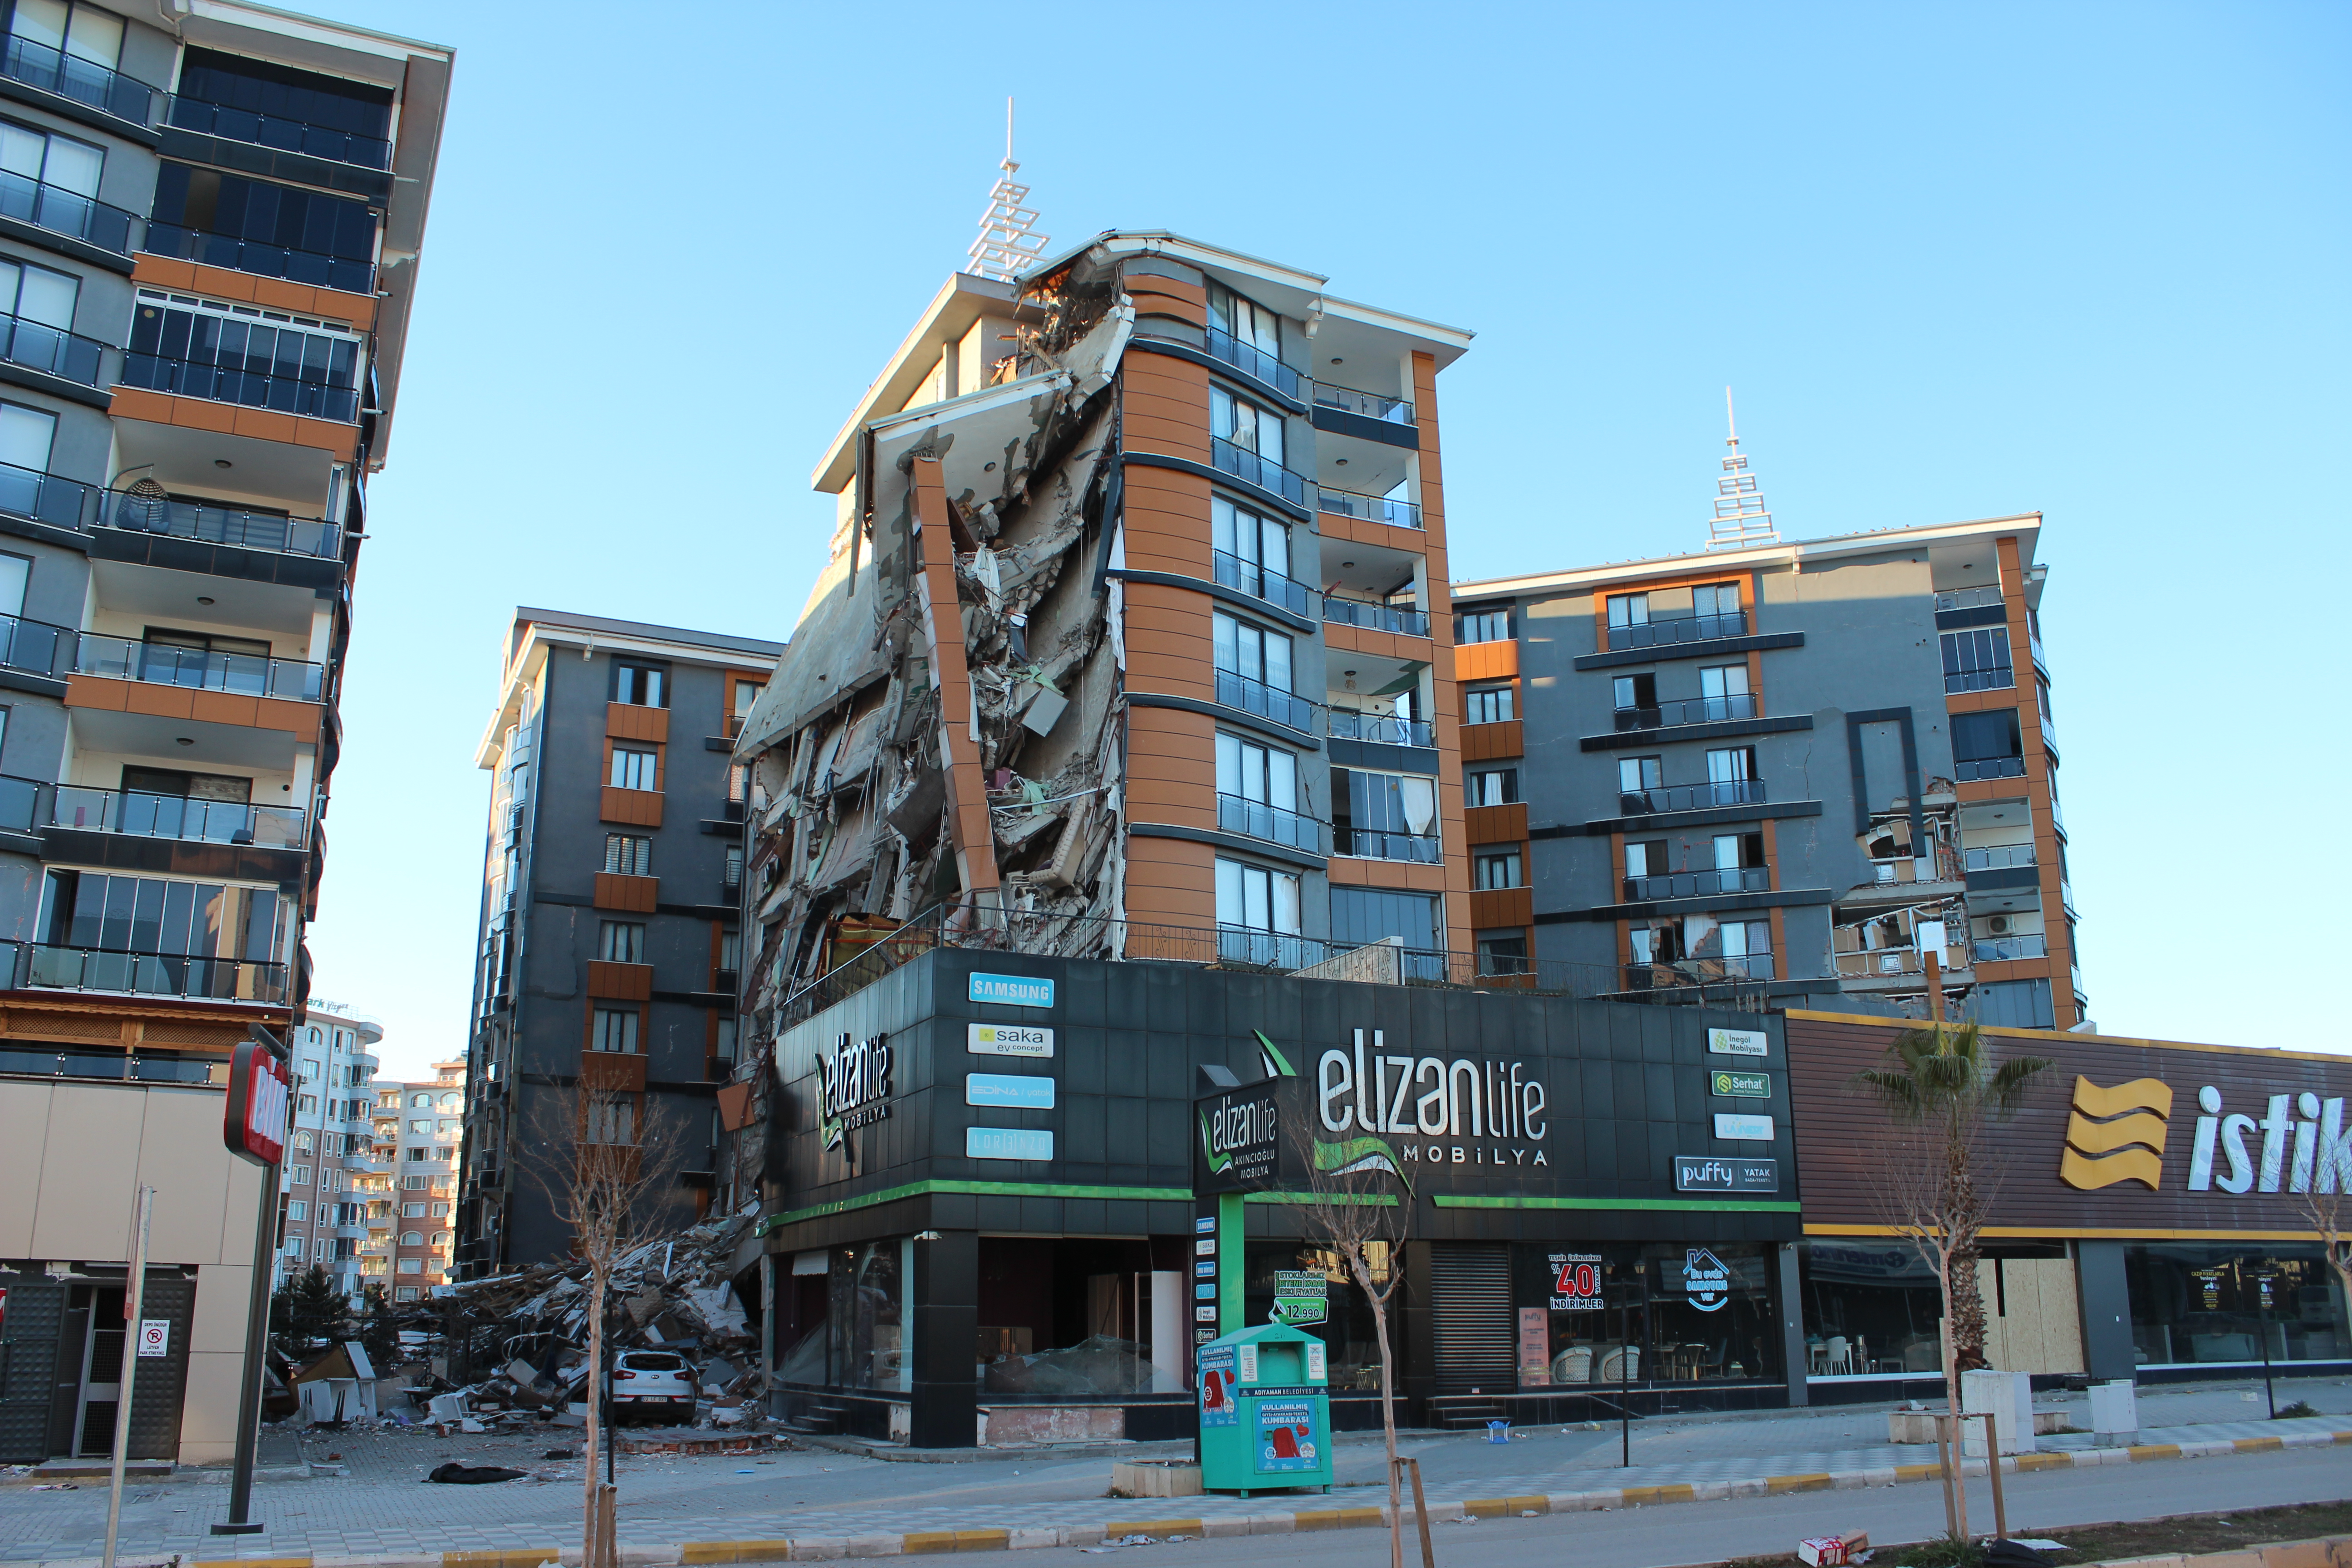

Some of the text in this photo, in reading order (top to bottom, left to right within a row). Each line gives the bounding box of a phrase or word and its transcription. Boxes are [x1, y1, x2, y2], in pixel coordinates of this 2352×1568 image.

[974, 980, 1049, 1000] SAMSUNG
[307, 998, 325, 1008] ark
[997, 1029, 1044, 1043] saka
[1729, 1033, 1750, 1044] İnegöl
[1730, 1044, 1762, 1054] Mobilyası
[1733, 1077, 1763, 1090] Serhat
[1027, 1088, 1050, 1098] yatak
[1235, 1149, 1275, 1166] AKINCIOĞLU
[1241, 1165, 1269, 1179] MOBİLYA
[1682, 1162, 1770, 1187] puffy YATAK
[1197, 1221, 1214, 1230] SAMSUNG
[1548, 1254, 1602, 1262] TEŞHİR ÜRÜNLERİNDE
[1690, 1268, 1723, 1279] Bu evde
[1686, 1280, 1728, 1291] SAMSUNG
[1700, 1293, 1715, 1301] var
[1550, 1297, 1604, 1310] İNDİRİMLER
[1525, 1312, 1541, 1321] puffy
[1201, 1346, 1233, 1356] KULLANILMIŞ
[1202, 1359, 1233, 1370] KUMBARASI
